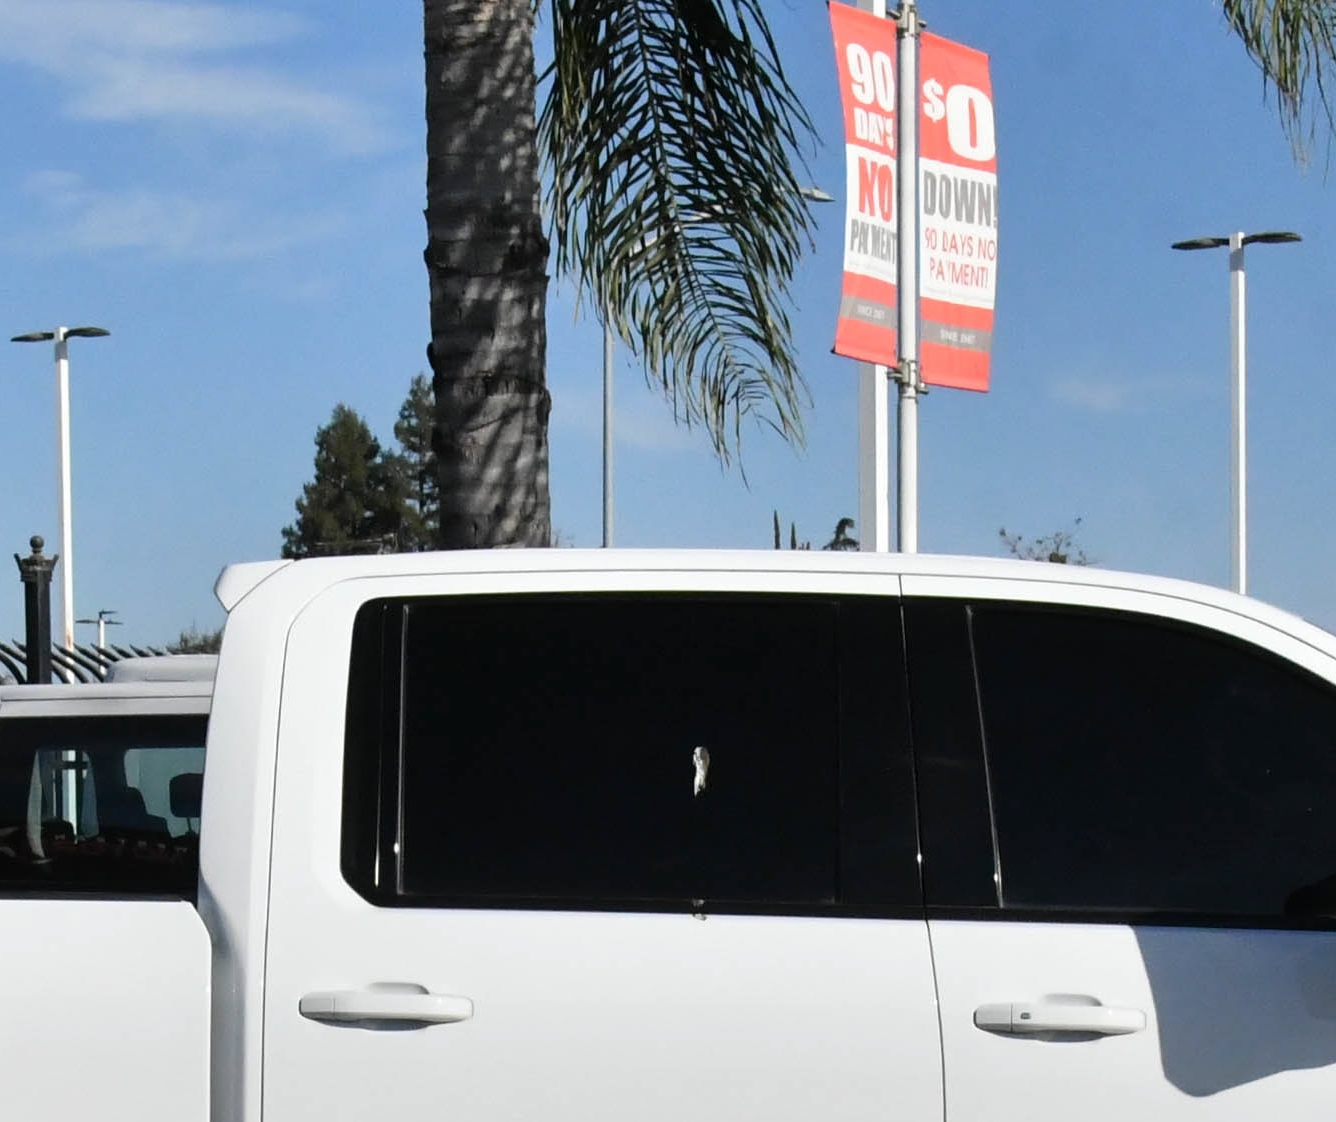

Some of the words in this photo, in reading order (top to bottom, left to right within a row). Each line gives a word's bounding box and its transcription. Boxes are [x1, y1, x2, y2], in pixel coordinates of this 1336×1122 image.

[846, 43, 895, 112] 90
[853, 107, 894, 150] DAYS
[923, 78, 996, 161] $0
[923, 170, 997, 228] DOWN!
[925, 227, 937, 250] 90
[942, 231, 973, 257] DAYS
[978, 237, 996, 261] NO
[929, 257, 988, 288] PAMENT!
